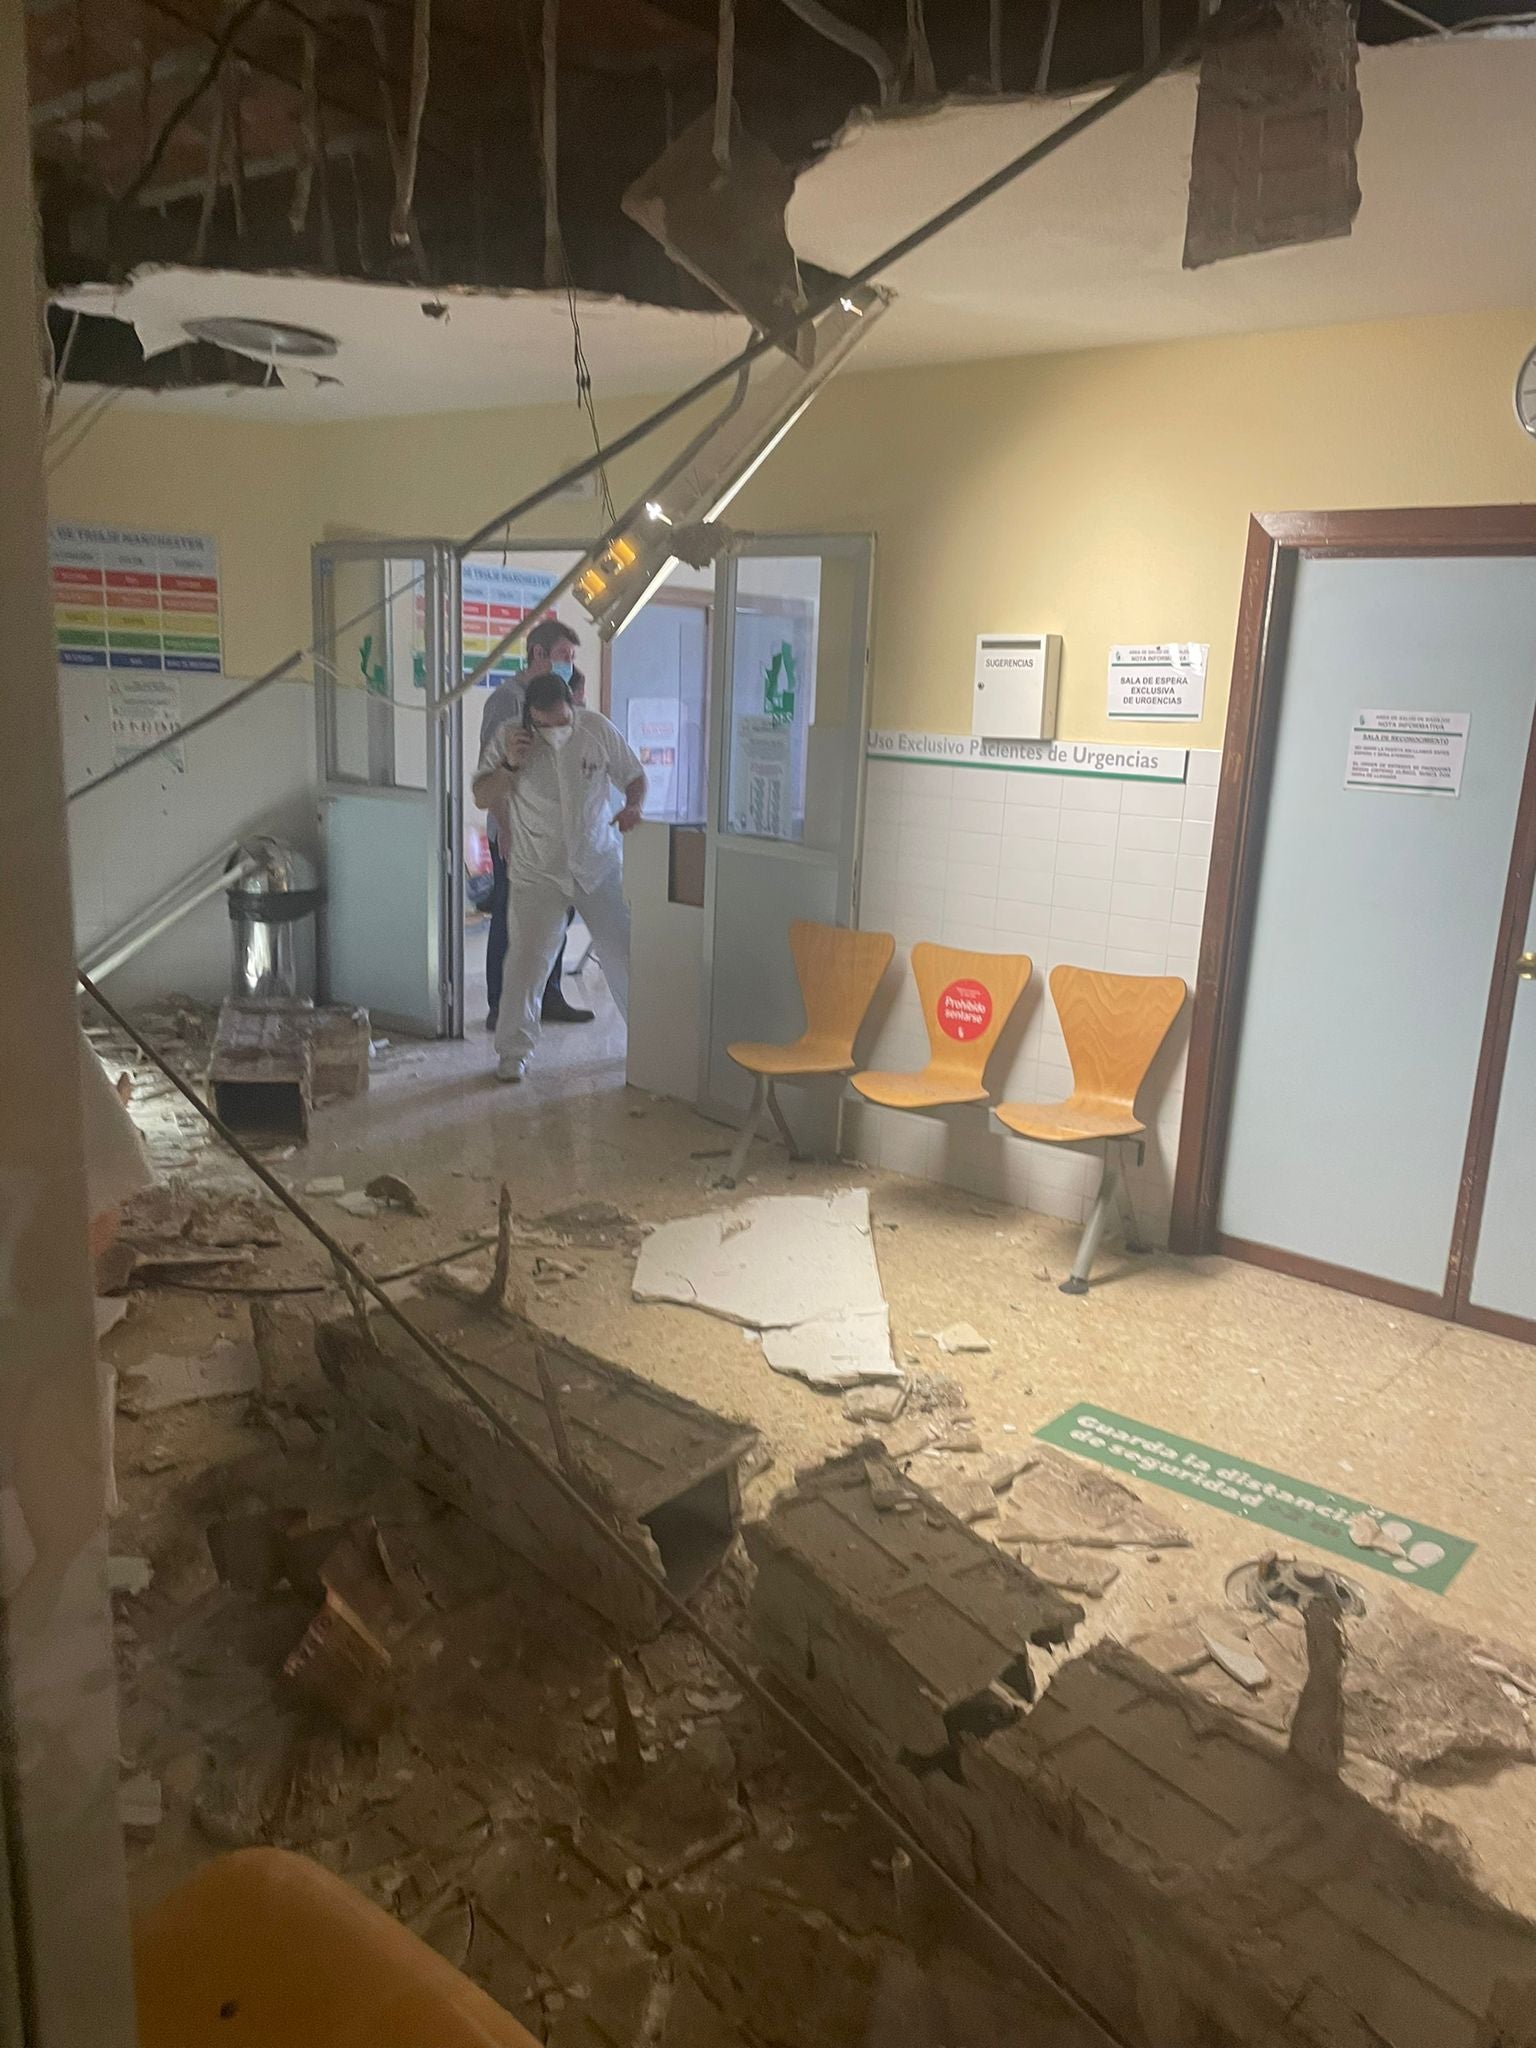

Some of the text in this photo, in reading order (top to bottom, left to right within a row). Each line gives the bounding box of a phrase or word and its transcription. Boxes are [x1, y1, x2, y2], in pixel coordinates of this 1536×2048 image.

[985, 658, 1034, 668] SUGERENCIAS
[1120, 677, 1189, 685] SALA DE ESPERA
[1131, 686, 1175, 695] EXCLUSIVA
[1123, 696, 1183, 705] DE URGENCIAS
[867, 730, 1159, 770] Uso Exclusivo Pacientes de Urgencias
[945, 995, 986, 1014] Prohibido
[944, 1009, 983, 1024] sentarse
[1077, 1415, 1178, 1460] Guarda
[1181, 1452, 1211, 1472] la
[1069, 1429, 1266, 1508] de seguridad
